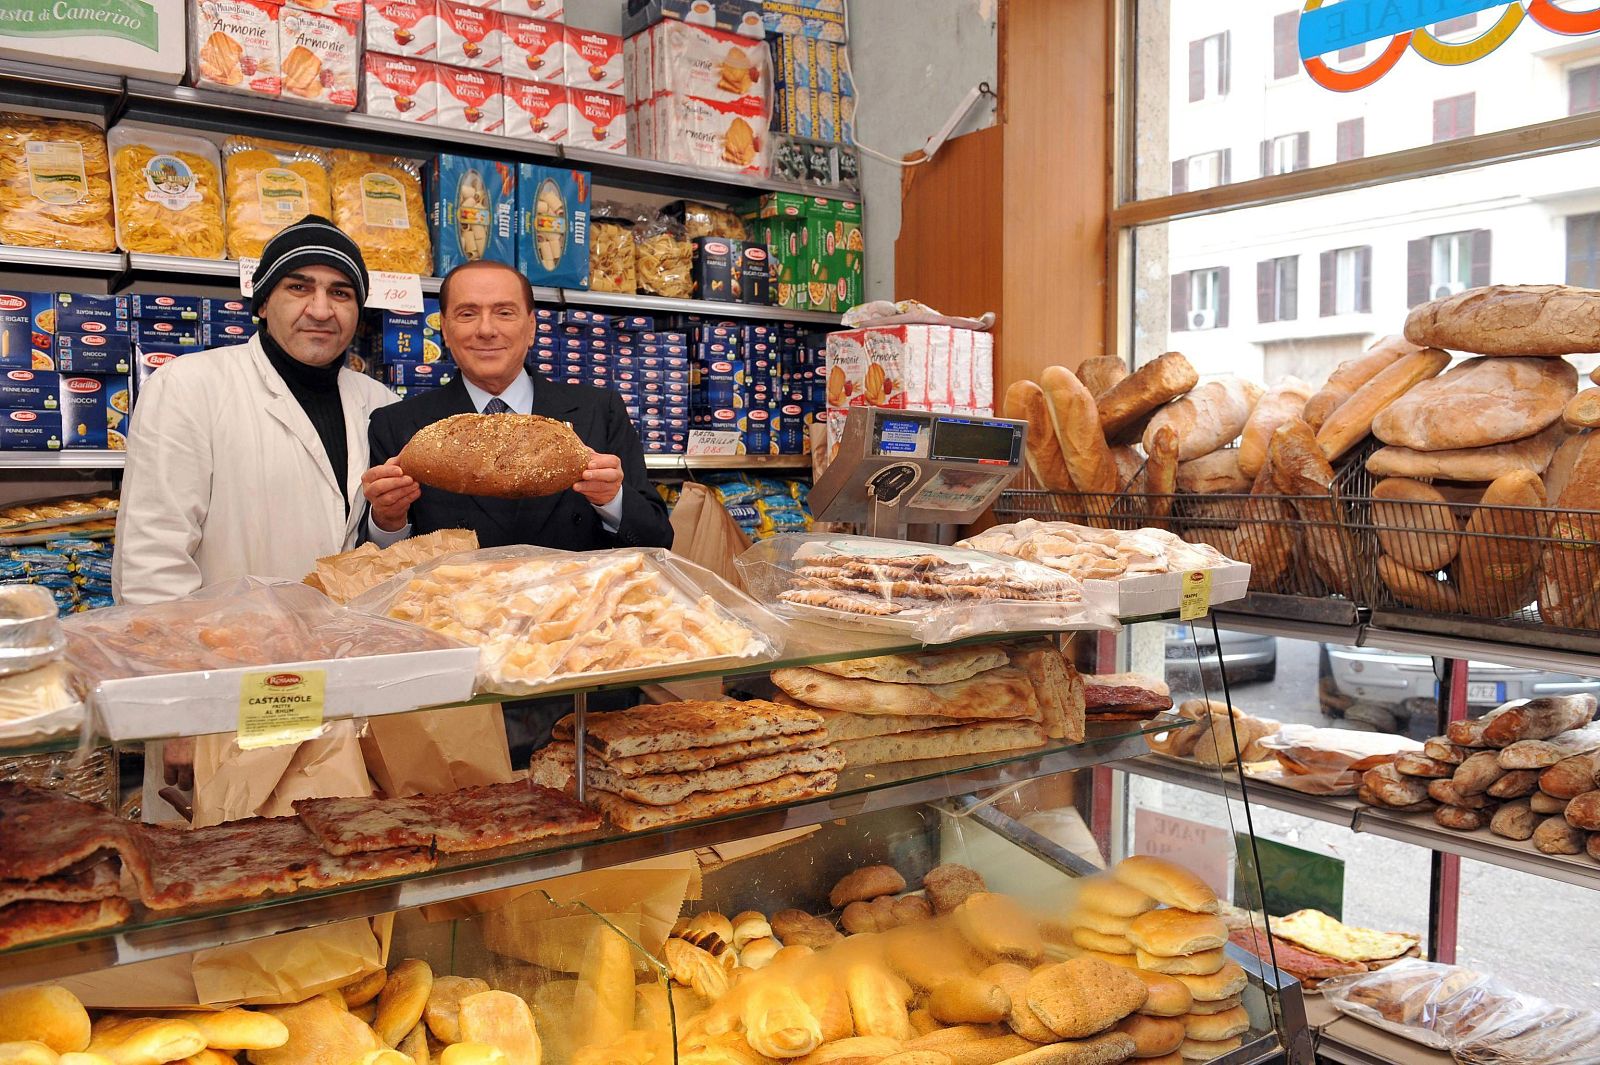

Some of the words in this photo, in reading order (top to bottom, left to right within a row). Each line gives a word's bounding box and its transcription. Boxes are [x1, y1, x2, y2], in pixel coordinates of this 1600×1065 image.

[38, 8, 50, 21] di
[53, 1, 141, 30] Camerino
[385, 5, 416, 20] ROSSA
[454, 8, 484, 20] LAVAZZA
[213, 19, 267, 38] Armonie
[455, 20, 484, 34] ROSSA
[518, 23, 546, 32] LAVAZZA
[295, 33, 345, 52] Armonie
[519, 33, 546, 47] ROSSA
[581, 35, 608, 46] LAVAZZA
[581, 45, 607, 58] ROSSA
[385, 61, 417, 72] LAVAZZA
[386, 73, 417, 87] ROSSA
[455, 73, 485, 84] LAVAZZA
[456, 85, 485, 99] ROSSA
[522, 86, 550, 95] LAVAZZA
[522, 96, 550, 109] ROSSA
[584, 95, 610, 106] LAVAZZA
[585, 105, 610, 119] ROSSA
[0, 298, 22, 307] arilla
[13, 371, 32, 379] Barilla
[70, 380, 98, 390] Barilla
[16, 412, 35, 420] Barilla
[248, 696, 312, 705] CASTAGNOLE
